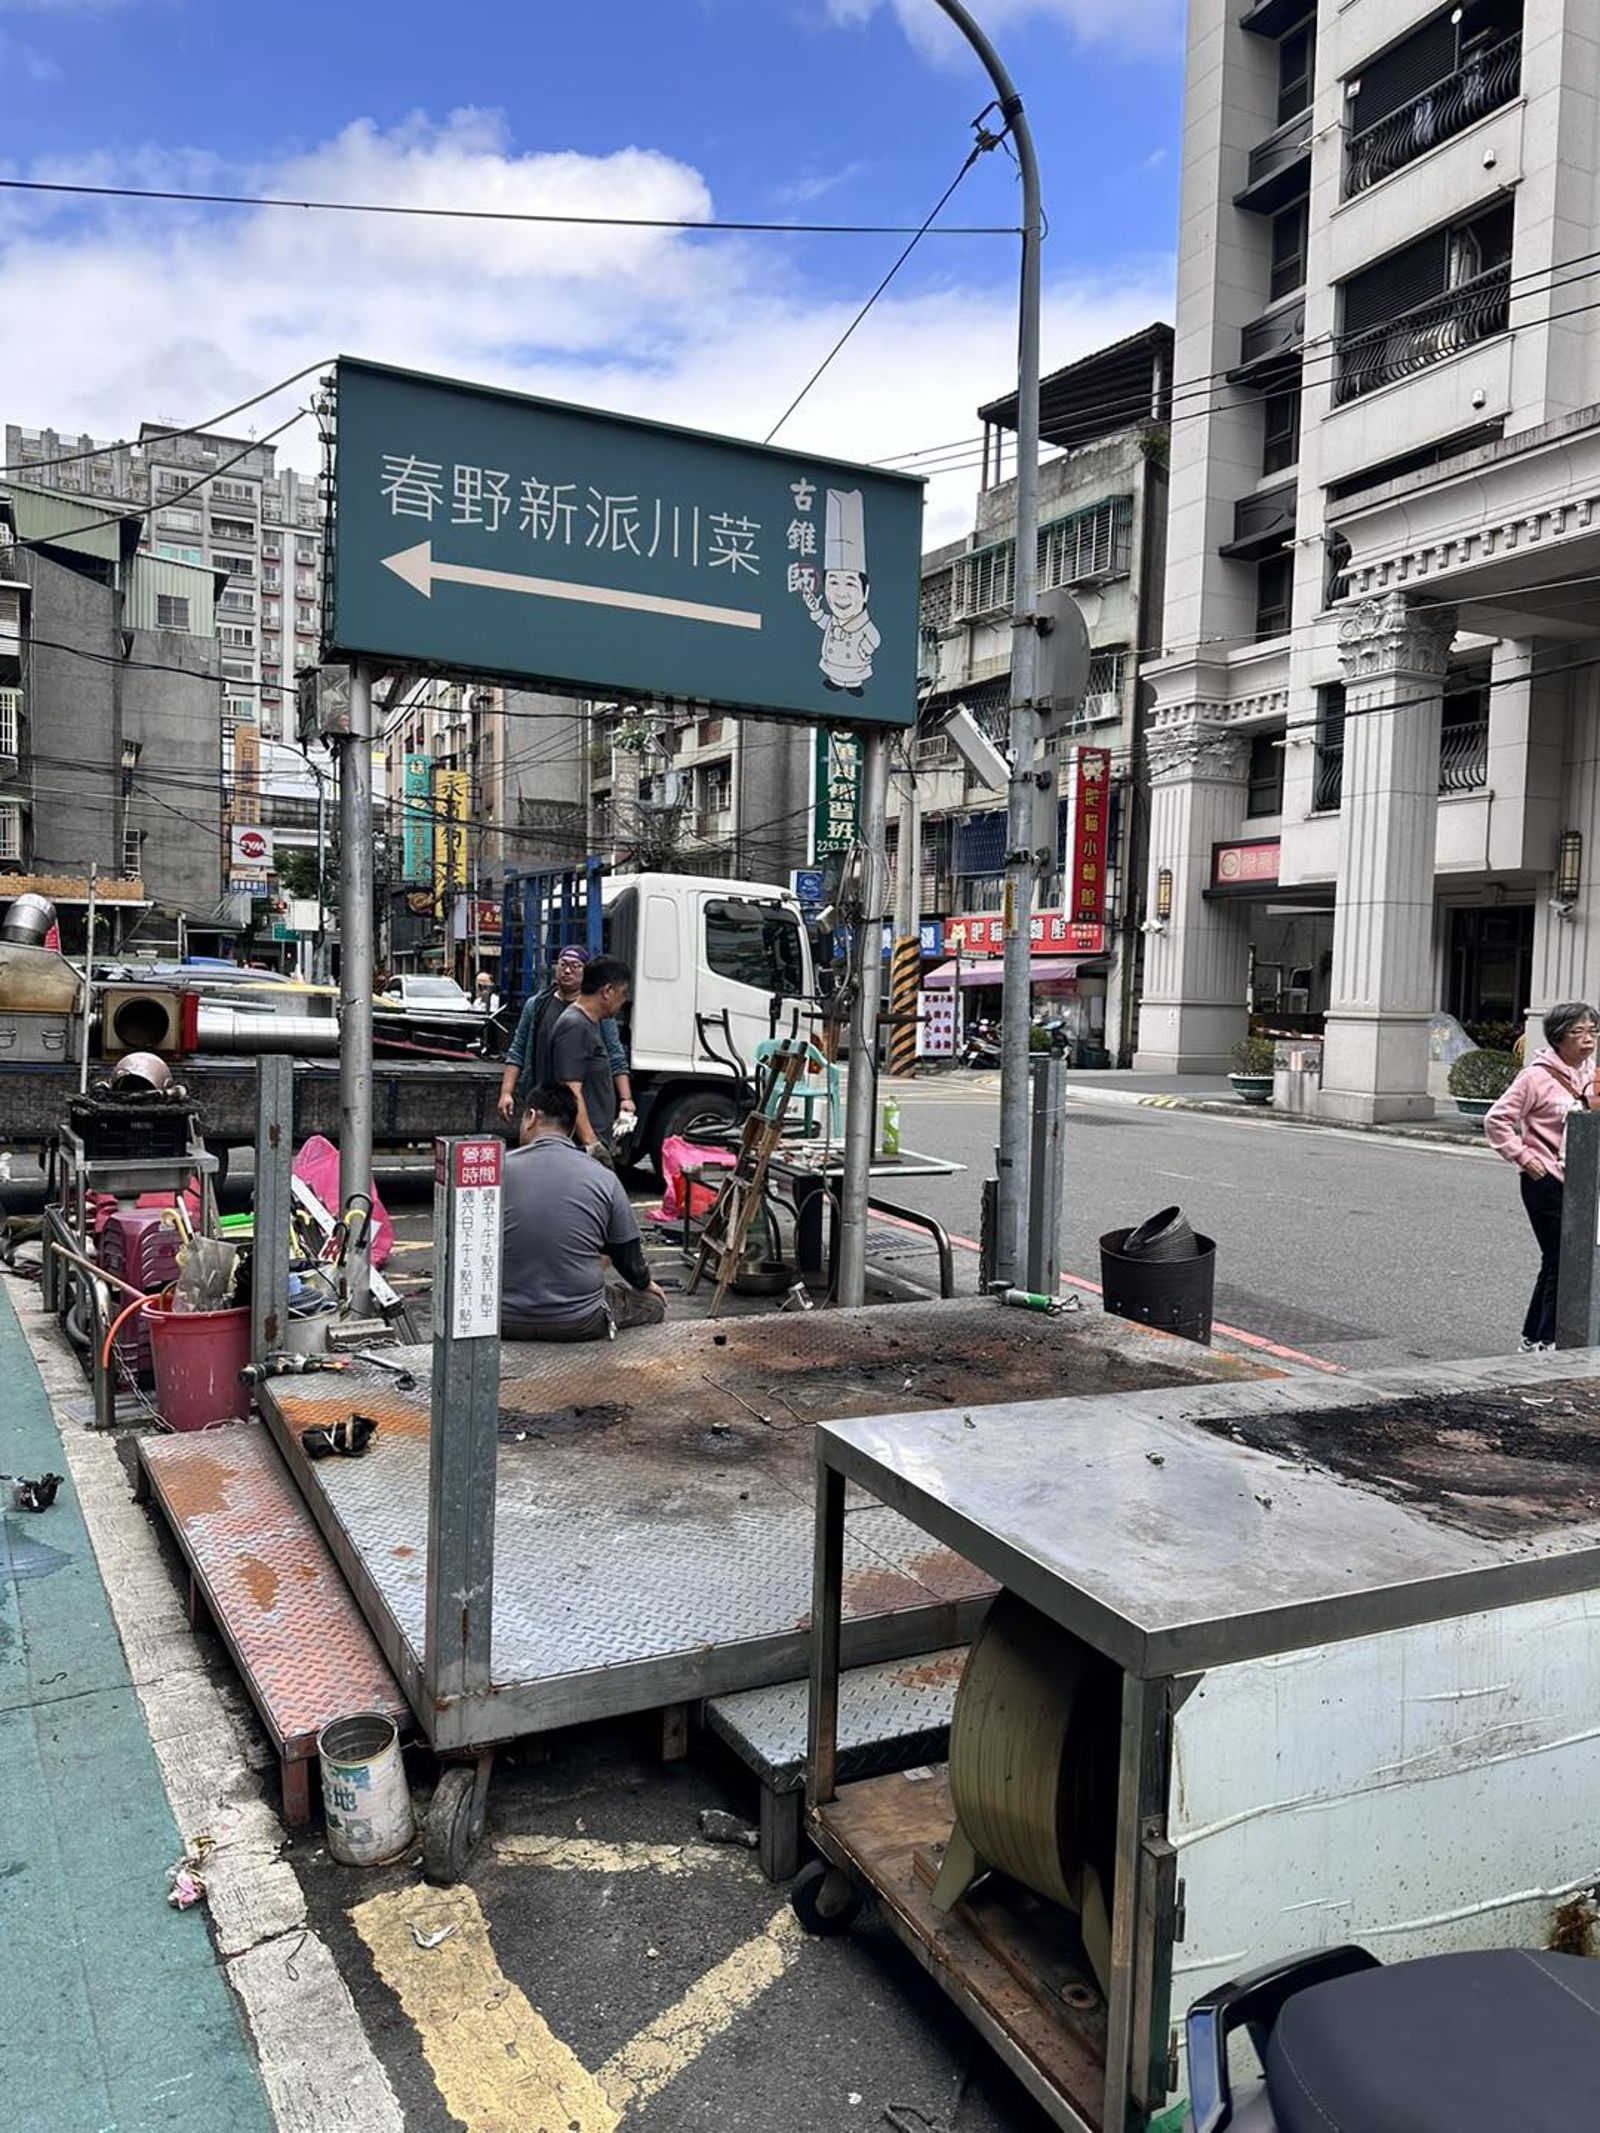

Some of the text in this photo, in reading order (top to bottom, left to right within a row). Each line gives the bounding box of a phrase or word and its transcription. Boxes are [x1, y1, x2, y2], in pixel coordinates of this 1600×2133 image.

[380, 453, 762, 577] 春野新派川菜
[786, 477, 818, 595] 古錐師
[239, 840, 266, 853] SYM
[970, 917, 1066, 943] 肥貓麵館
[462, 1146, 497, 1164] 營業
[462, 1166, 496, 1184] 時間
